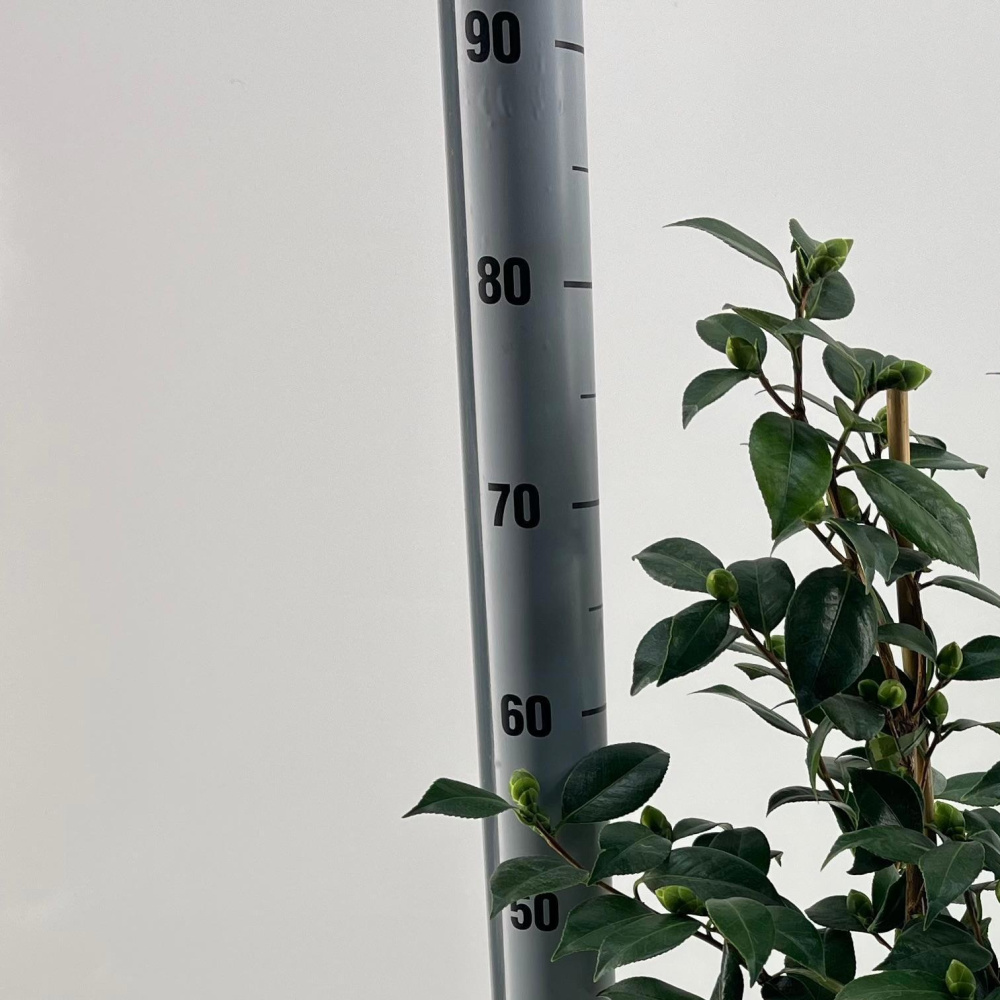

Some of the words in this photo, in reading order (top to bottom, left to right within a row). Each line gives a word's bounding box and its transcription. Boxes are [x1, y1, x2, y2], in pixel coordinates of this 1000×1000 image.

[465, 10, 521, 64] 90
[477, 255, 531, 306] 80
[487, 482, 541, 530] 70
[500, 693, 552, 738] 60
[510, 892, 559, 932] 50
